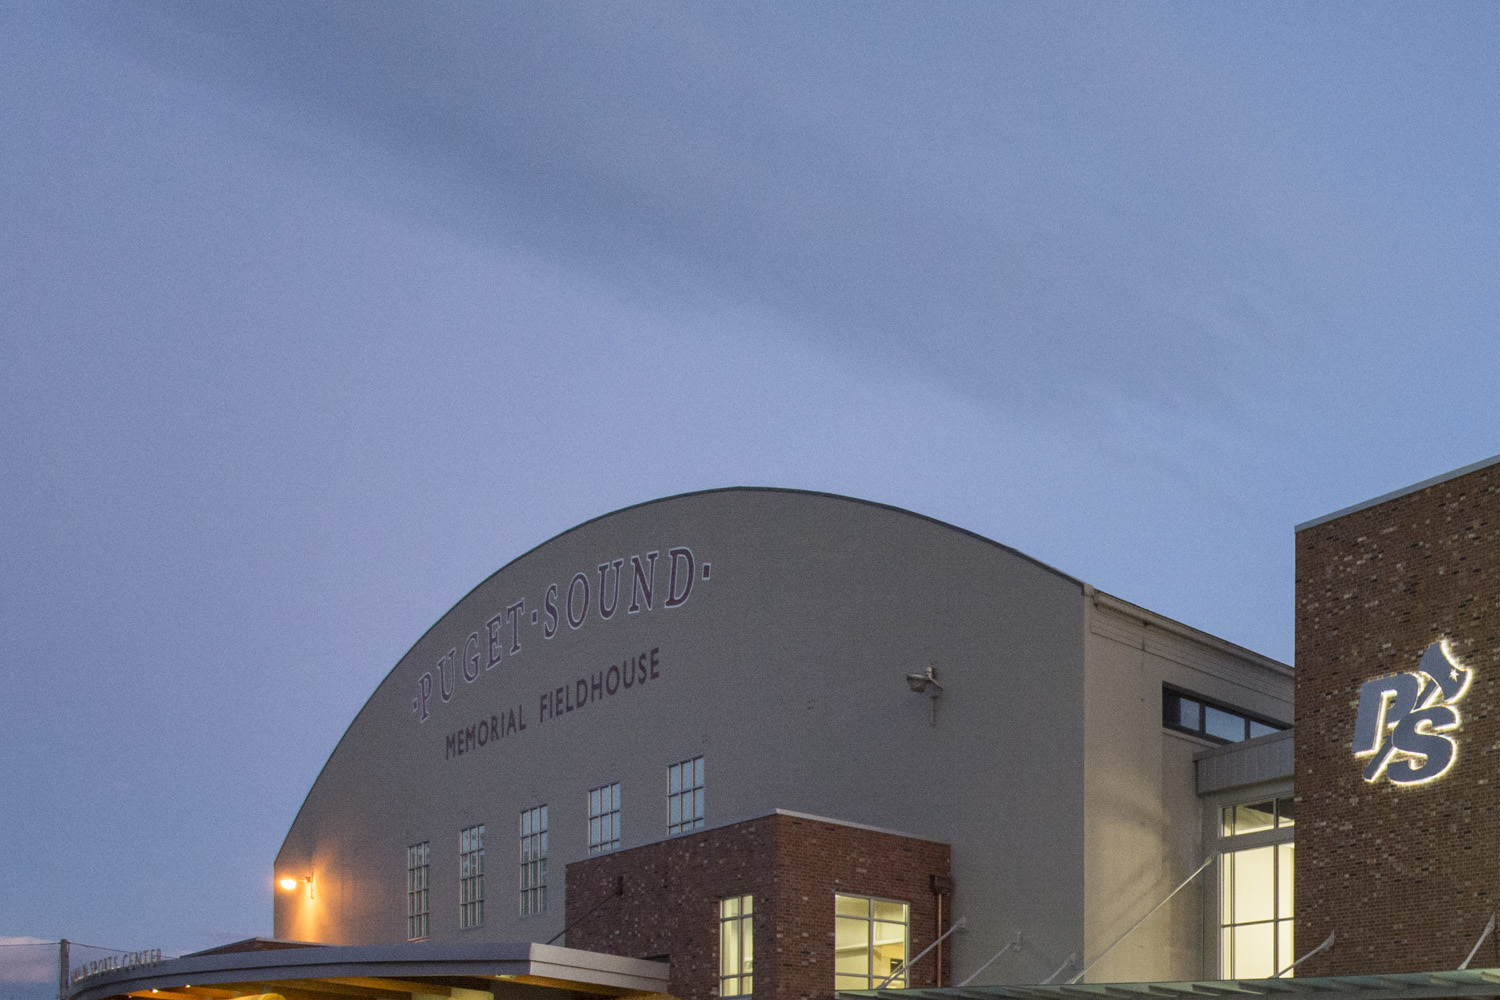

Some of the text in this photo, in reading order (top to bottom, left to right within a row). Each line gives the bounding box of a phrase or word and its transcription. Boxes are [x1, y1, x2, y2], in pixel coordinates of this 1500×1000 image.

[445, 647, 660, 760] MEMORIAL FIELDHOUSE
[89, 956, 120, 974] SPORTS
[122, 948, 162, 967] CENTER
